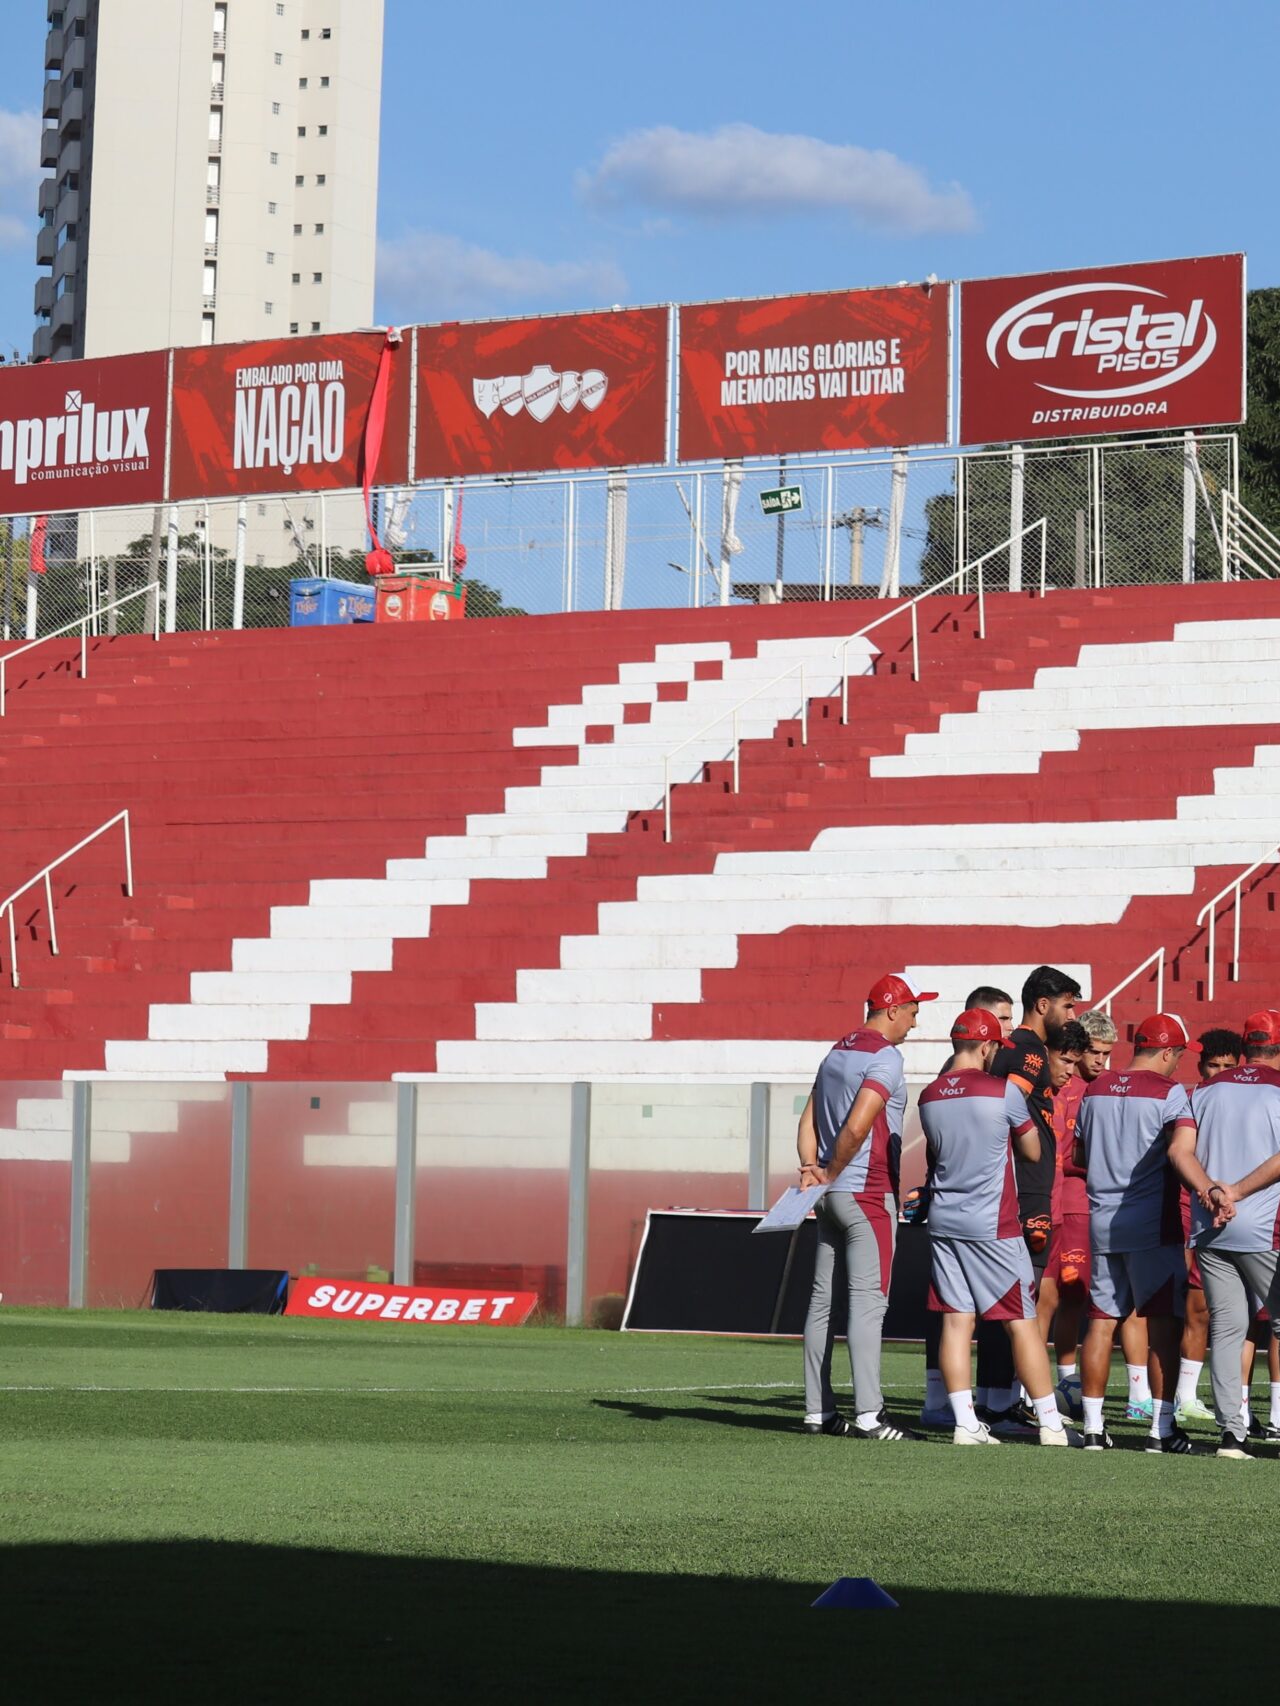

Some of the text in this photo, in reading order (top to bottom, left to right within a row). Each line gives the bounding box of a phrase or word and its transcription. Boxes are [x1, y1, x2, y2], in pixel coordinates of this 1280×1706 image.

[1007, 299, 1203, 361] Cristal
[725, 338, 901, 377] POR MAIS GLÓRIAS E
[1097, 349, 1179, 373] PISOS
[236, 360, 344, 388] EMBALADO POR UMA
[720, 367, 905, 406] MEMÓRIAS VAI LUTAR
[1032, 401, 1168, 424] DISTRIBUIDORA
[31, 457, 149, 480] comunicação visual
[1109, 1084, 1132, 1093] VOLT
[1233, 1074, 1260, 1083] VOLT
[939, 1087, 966, 1096] VOLT
[1060, 1251, 1087, 1264] Sesc
[308, 1285, 515, 1321] SUPERBET
